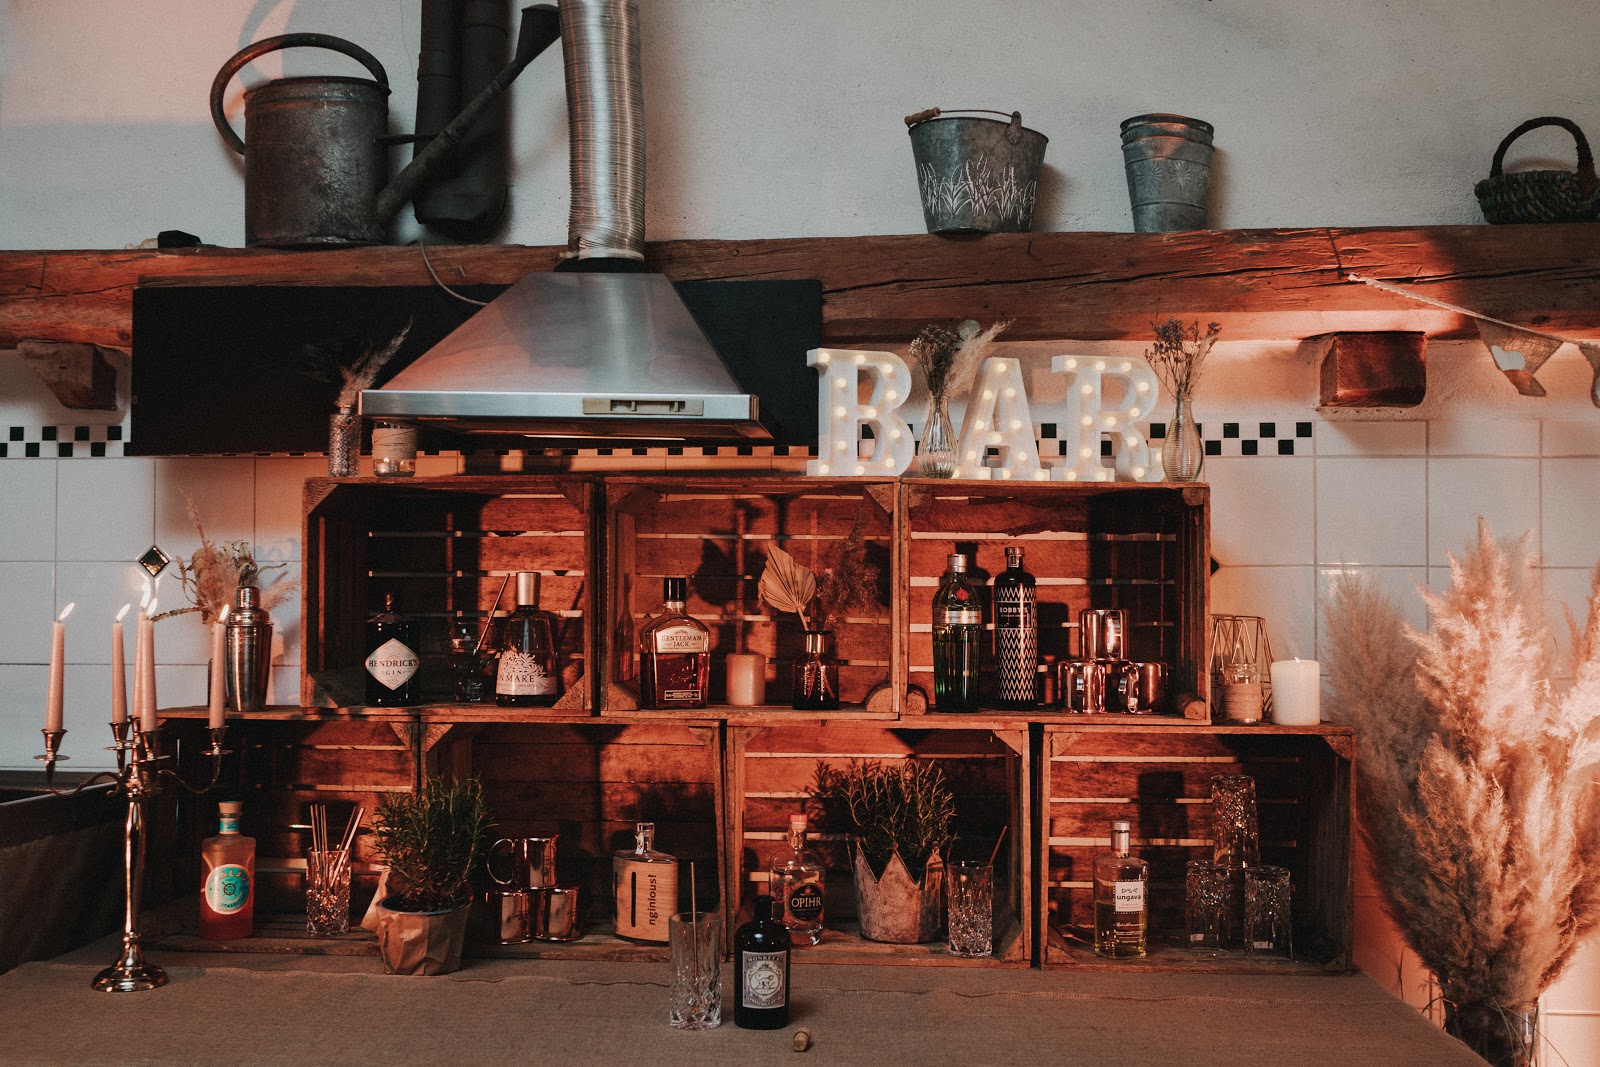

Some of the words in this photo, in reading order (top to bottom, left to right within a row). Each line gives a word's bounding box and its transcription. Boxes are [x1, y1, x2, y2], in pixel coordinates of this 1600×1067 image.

[806, 347, 1165, 483] BAR
[368, 658, 418, 668] HENDRICK'S
[505, 674, 534, 683] MARE
[647, 874, 658, 926] nginious!
[791, 896, 822, 908] OPIHR
[746, 955, 776, 963] MONKEY
